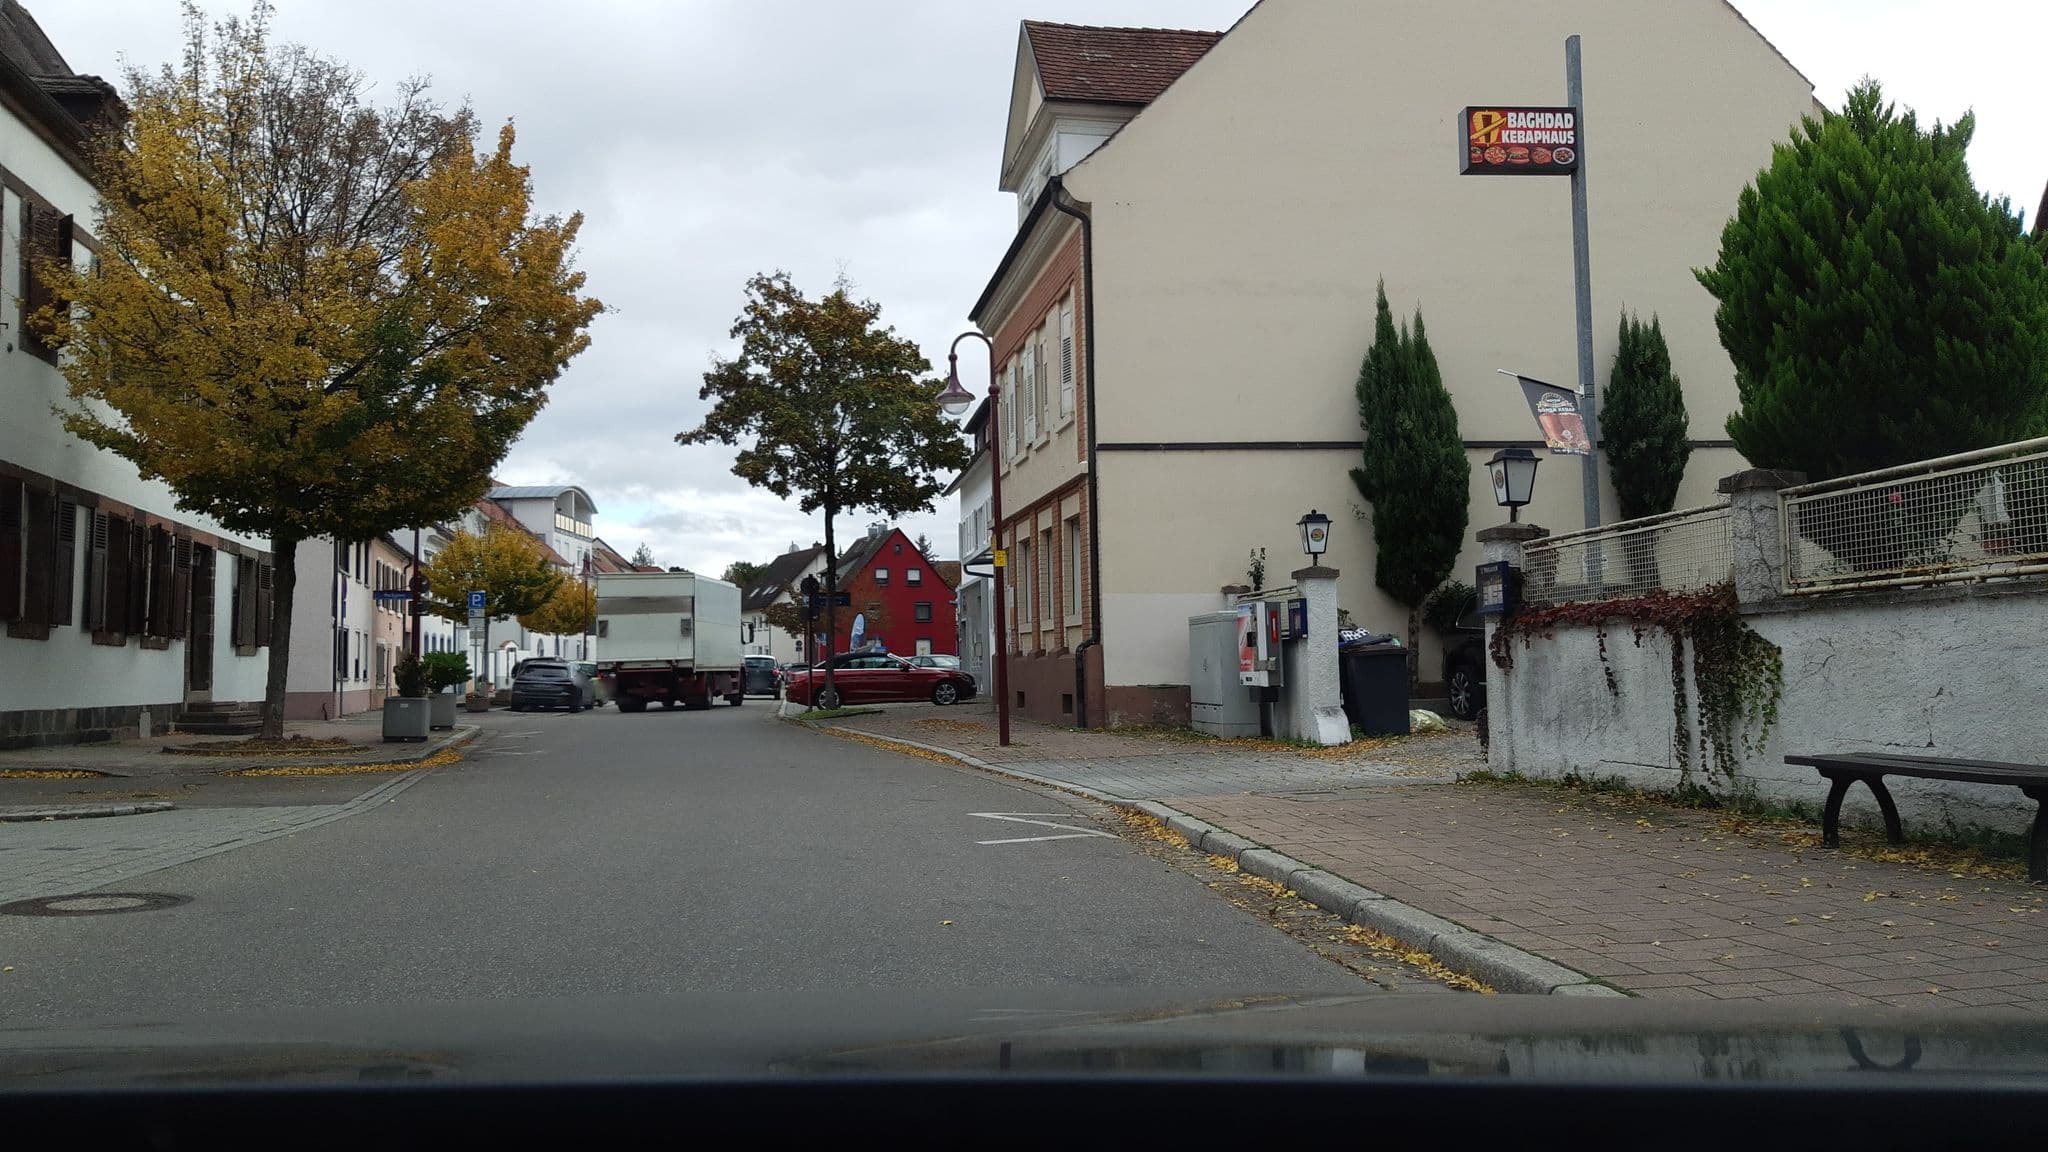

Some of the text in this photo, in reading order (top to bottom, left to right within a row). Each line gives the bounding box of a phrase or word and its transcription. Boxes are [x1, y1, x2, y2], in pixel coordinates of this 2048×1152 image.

[1507, 112, 1574, 129] BAGHDAD
[1501, 130, 1575, 144] KEBAPHAUS
[471, 593, 482, 607] P
